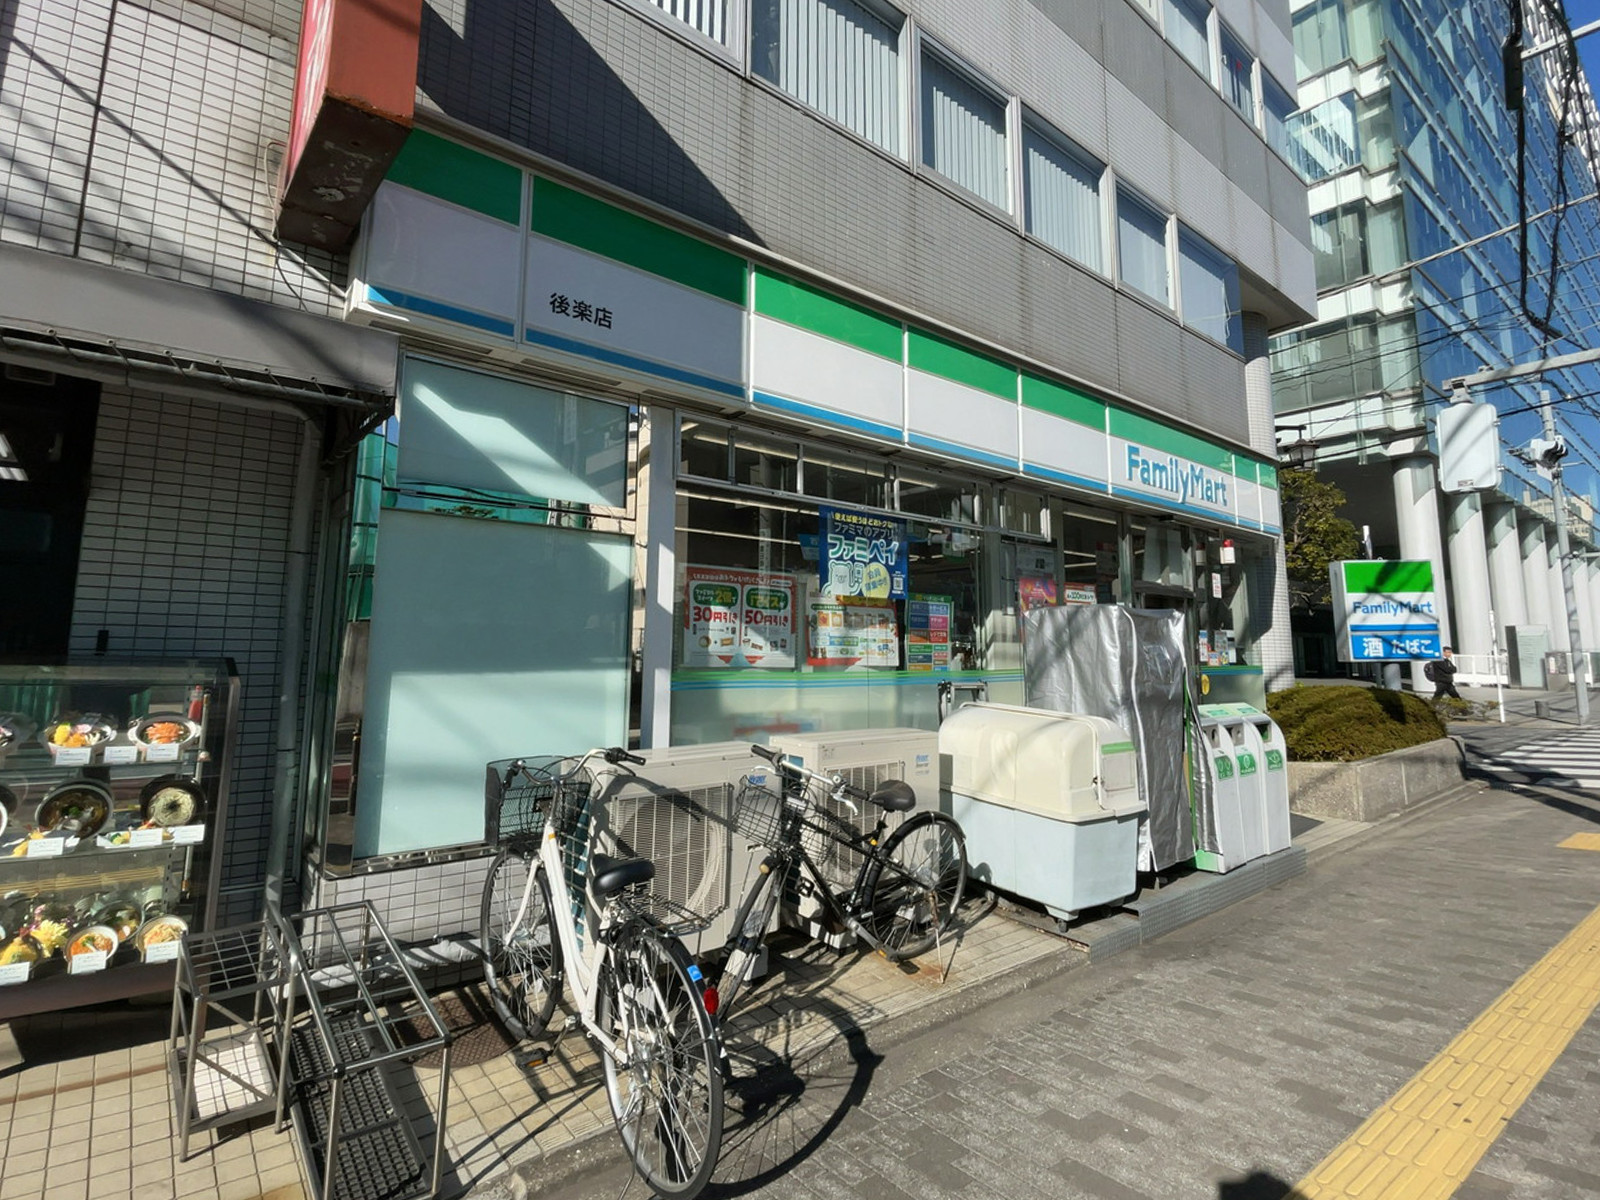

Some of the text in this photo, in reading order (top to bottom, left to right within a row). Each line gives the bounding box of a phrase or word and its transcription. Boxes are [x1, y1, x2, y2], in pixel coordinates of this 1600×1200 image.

[549, 293, 613, 330] 後楽店
[1126, 443, 1228, 506] FamilyMart
[834, 522, 894, 539] ファミマのアプリ
[827, 533, 899, 566] ファミペイ
[1353, 600, 1433, 617] FamilyMart
[1362, 637, 1434, 657] 酒 たばこ
